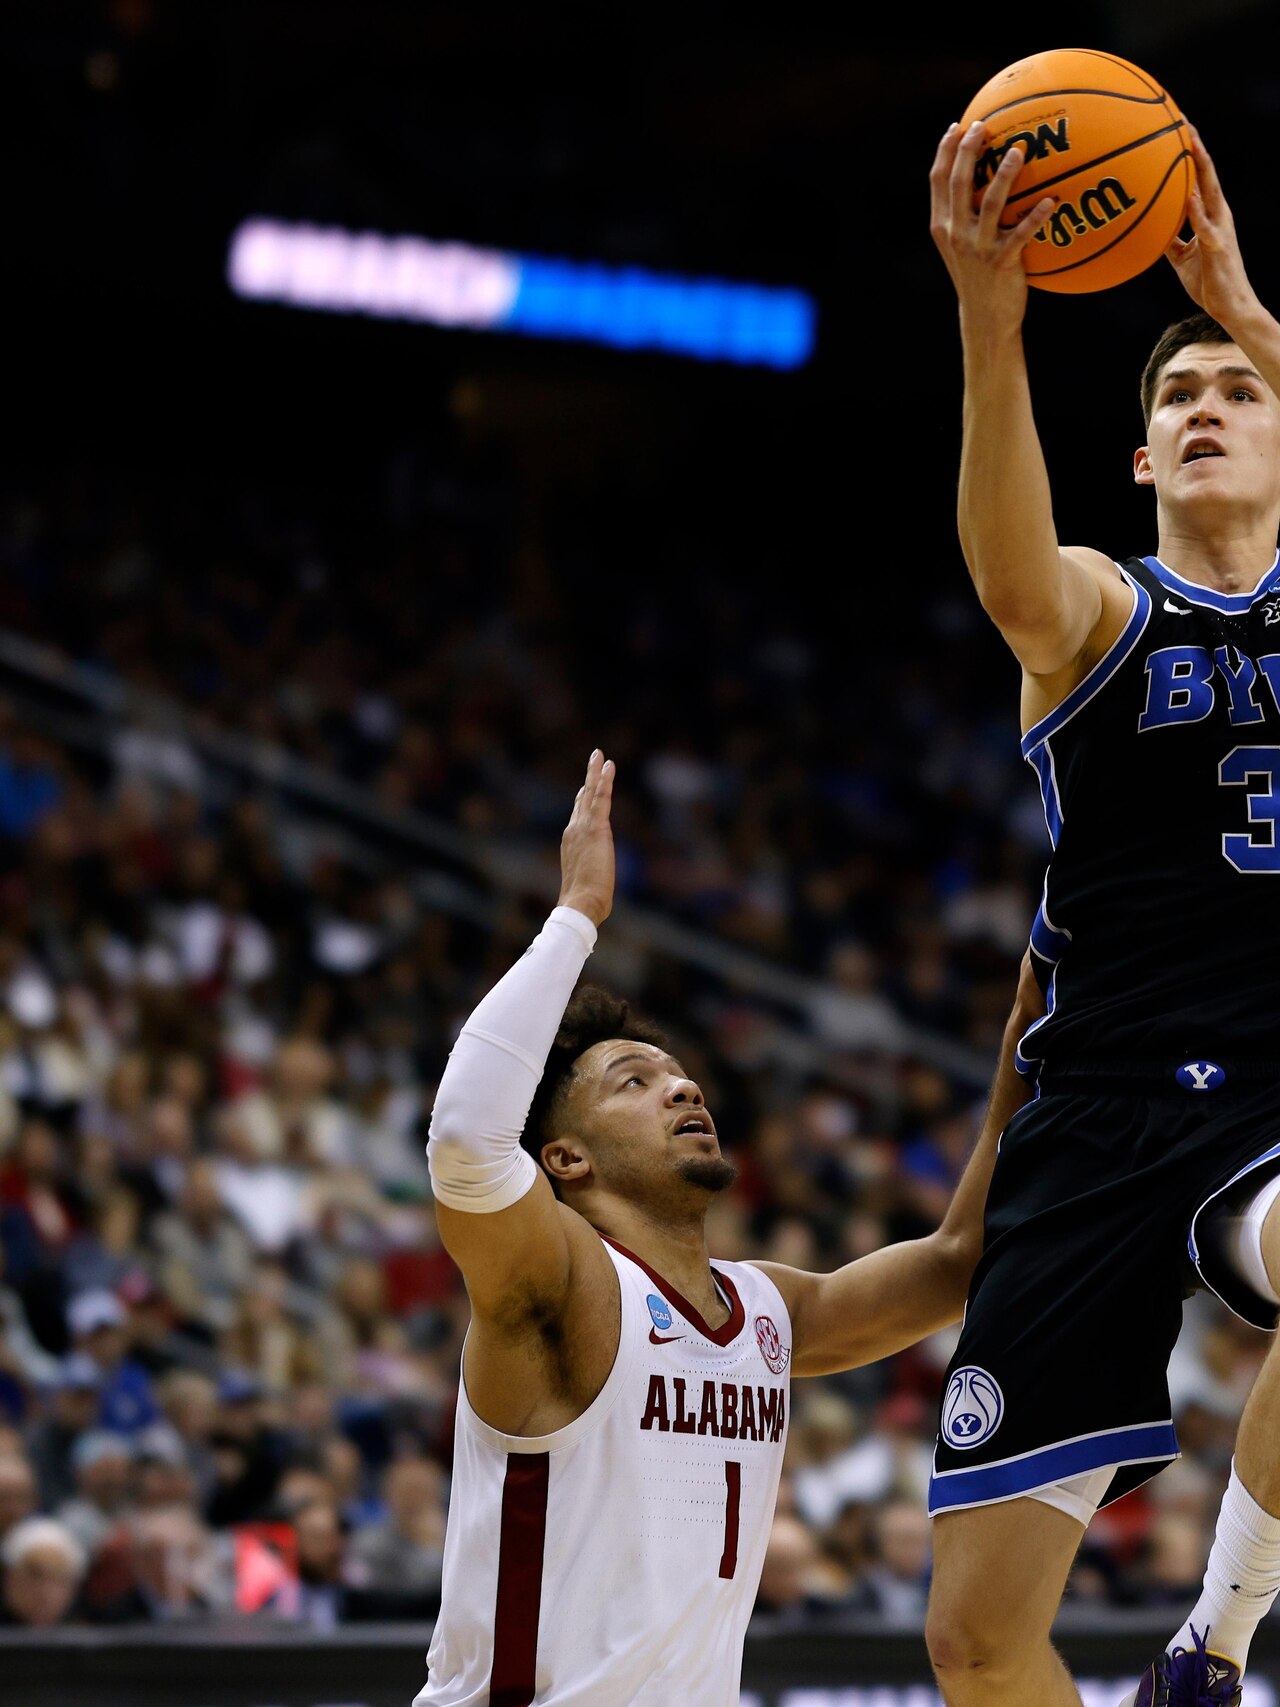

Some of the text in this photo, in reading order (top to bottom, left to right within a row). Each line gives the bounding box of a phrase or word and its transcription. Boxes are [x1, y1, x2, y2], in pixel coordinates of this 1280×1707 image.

[1033, 177, 1136, 247] Wil
[1183, 1063, 1218, 1089] Y
[640, 1374, 785, 1443] ALABAMA
[955, 1415, 977, 1435] Y
[718, 1460, 741, 1580] 1
